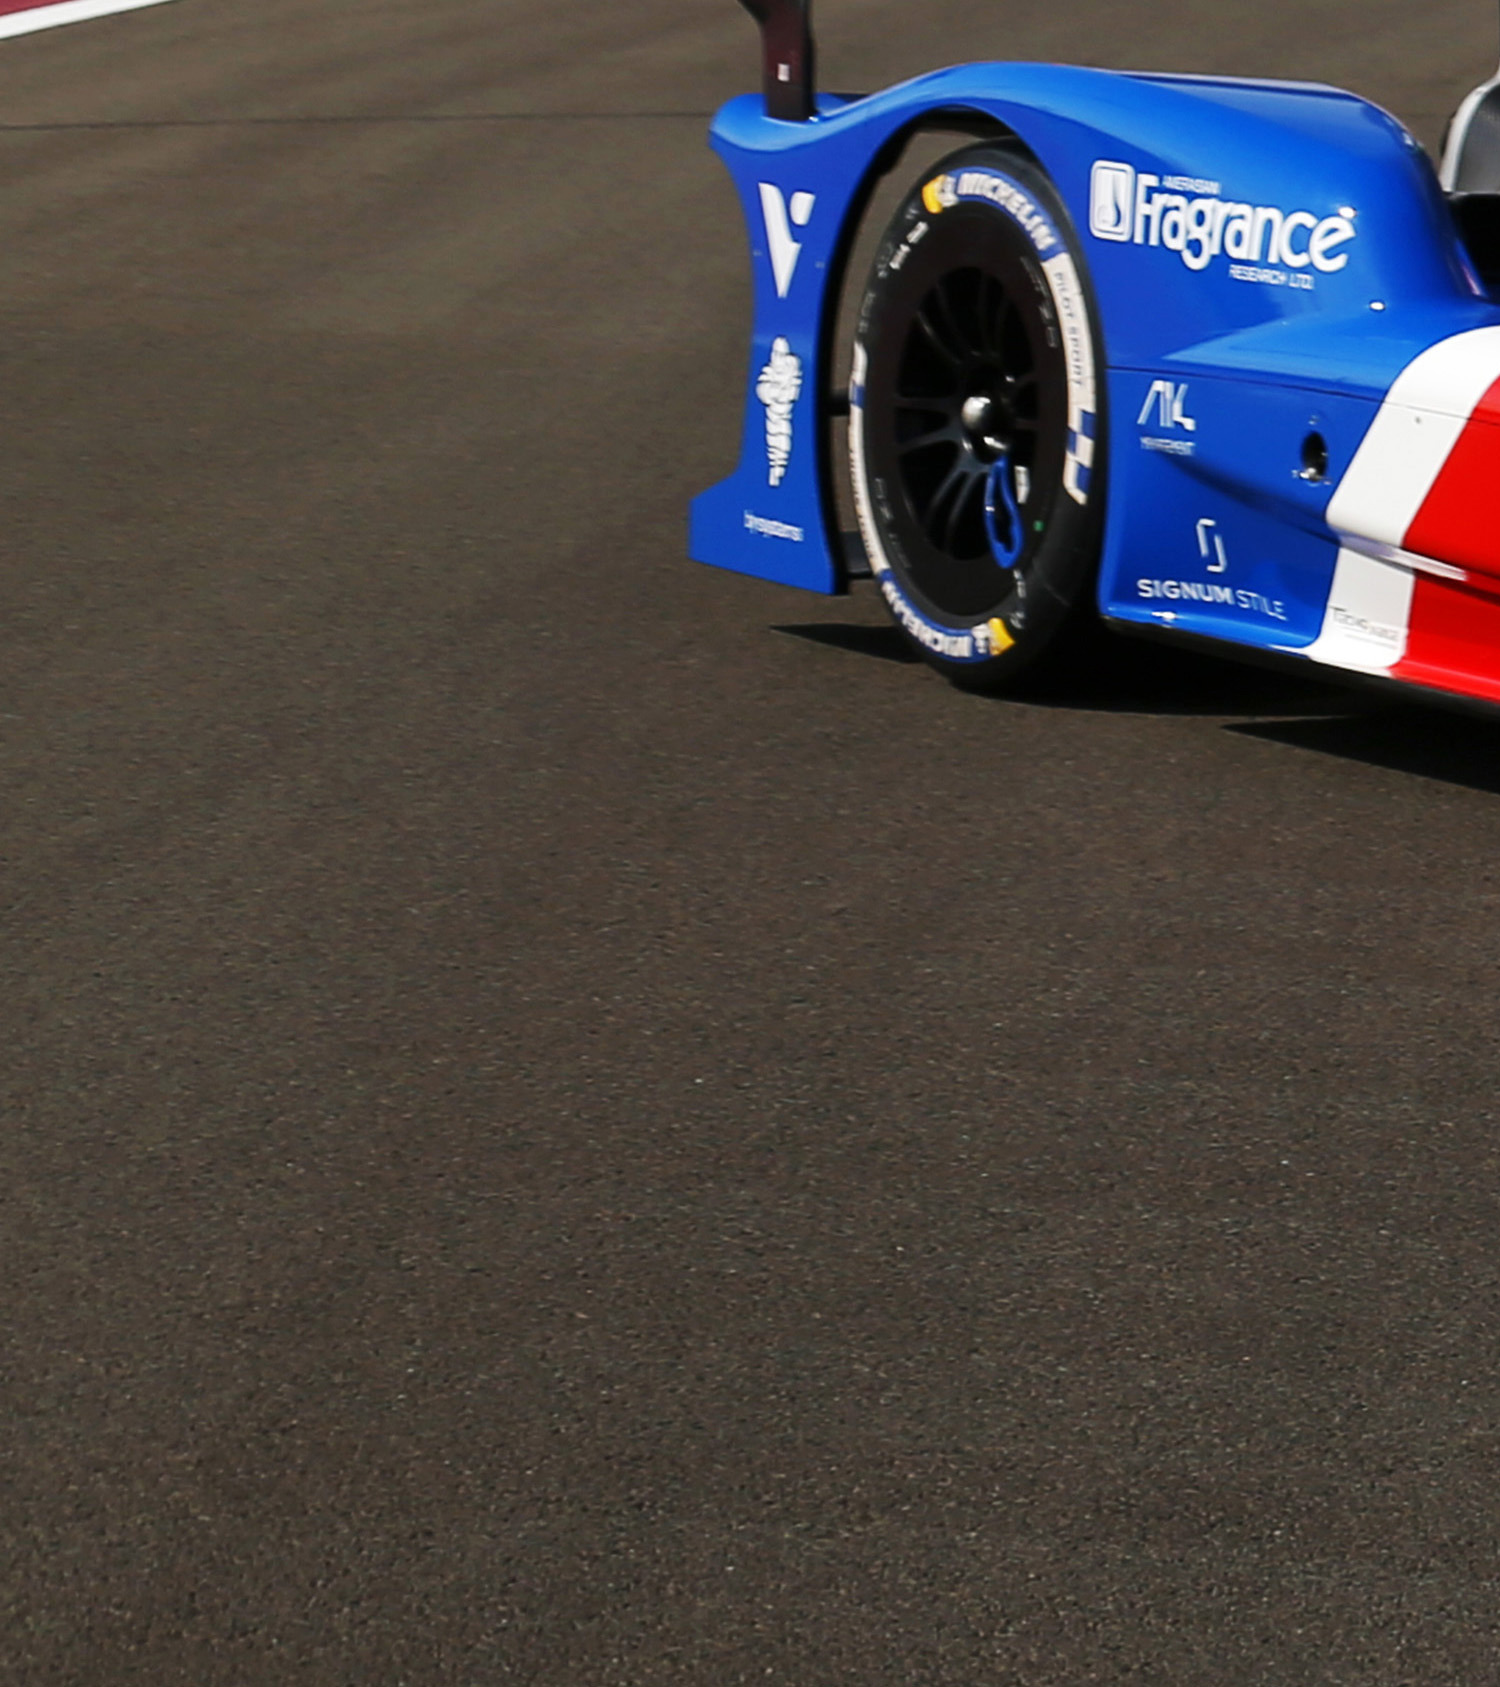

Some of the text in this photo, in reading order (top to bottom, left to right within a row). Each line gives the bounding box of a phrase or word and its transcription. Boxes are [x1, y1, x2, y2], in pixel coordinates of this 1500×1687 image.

[1133, 173, 1356, 273] Fragrance
[1136, 578, 1289, 622] SIGNUM STILE
